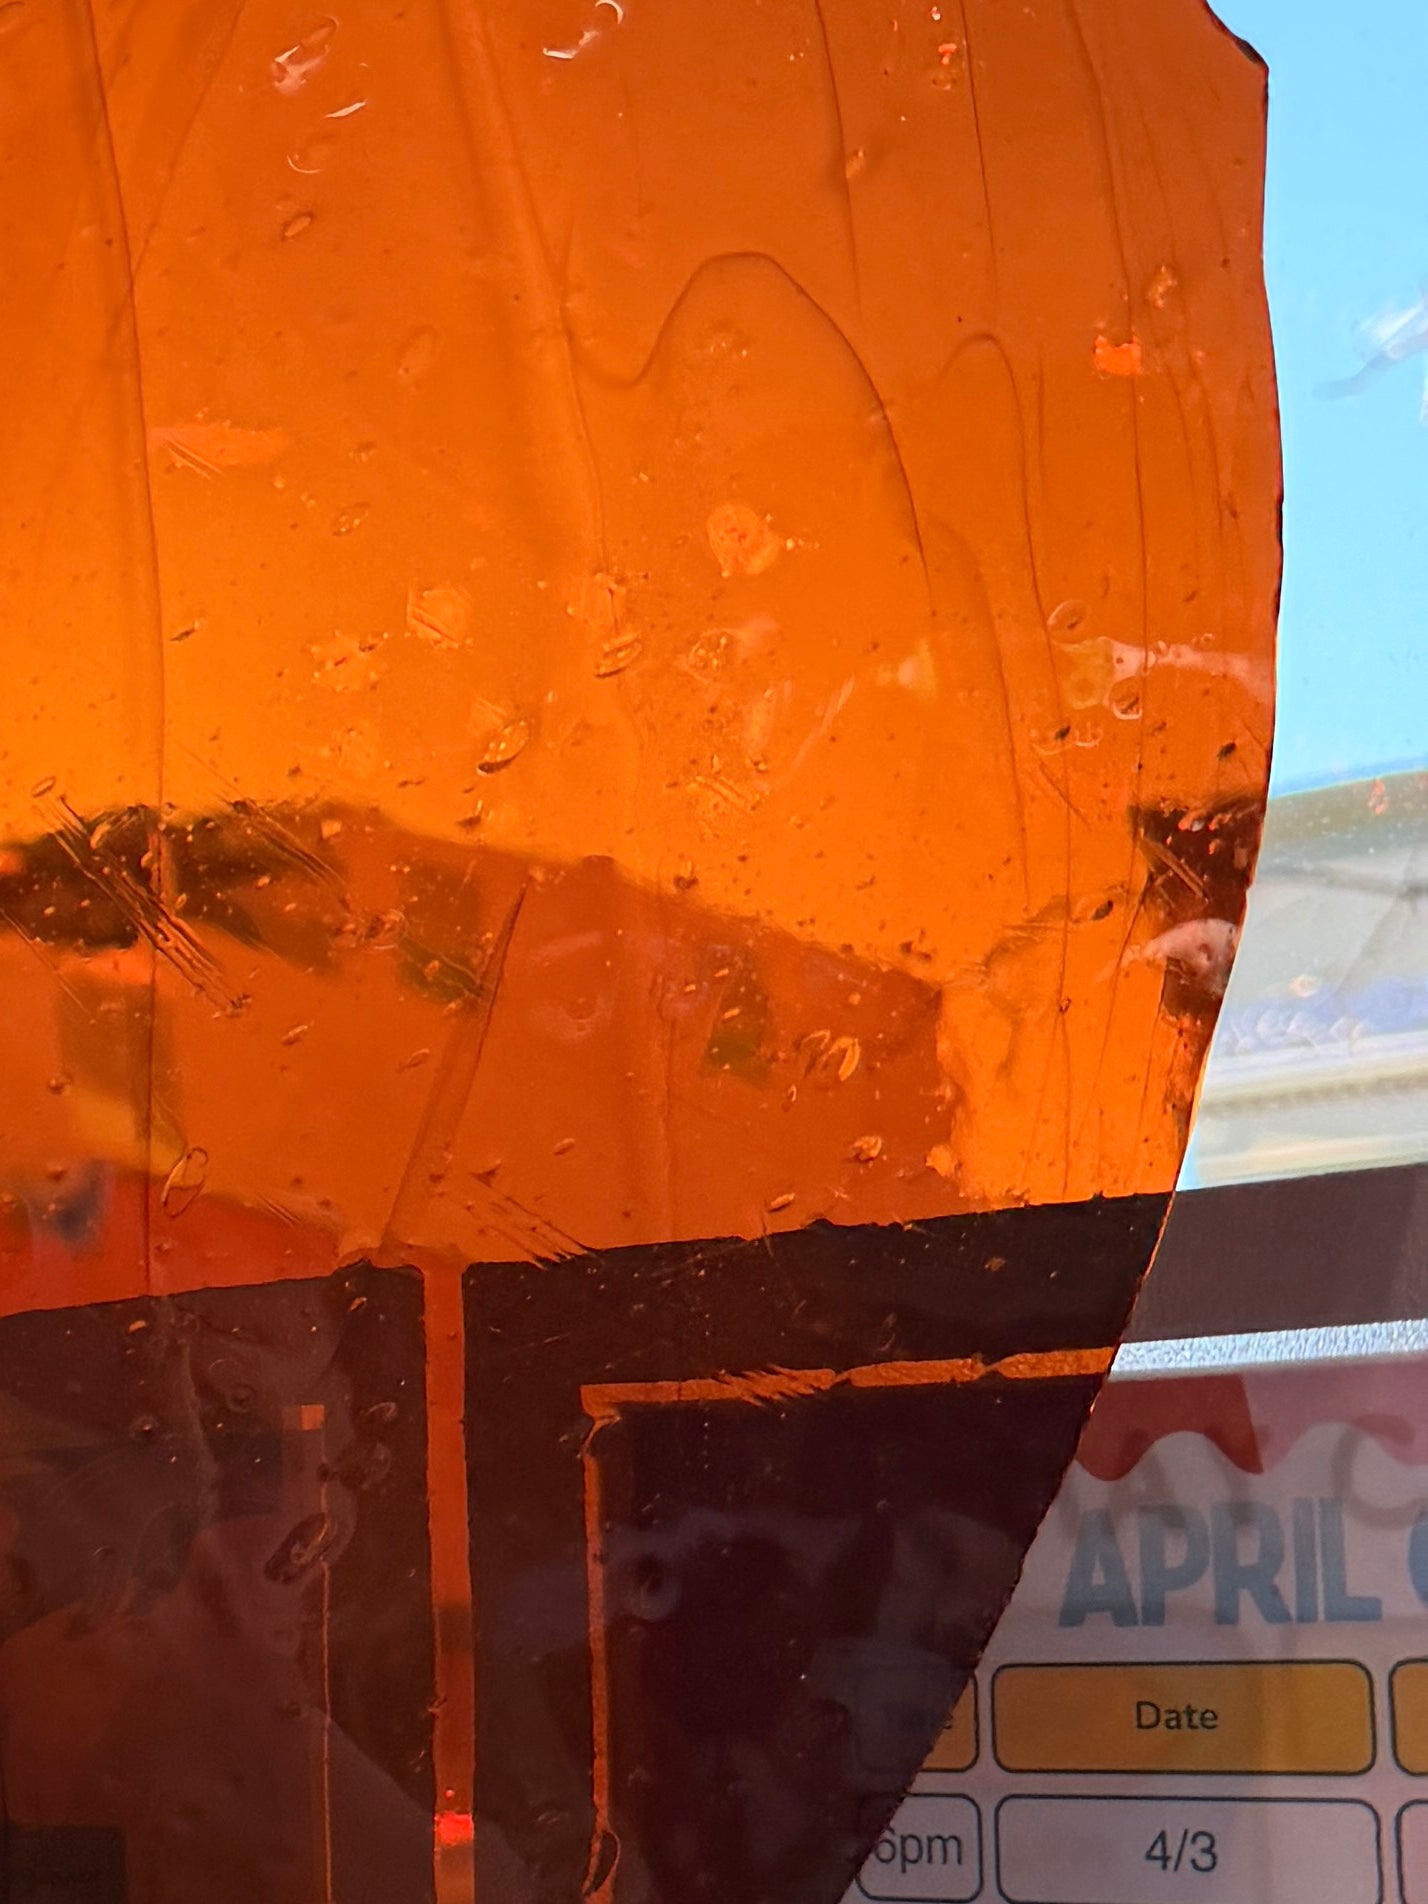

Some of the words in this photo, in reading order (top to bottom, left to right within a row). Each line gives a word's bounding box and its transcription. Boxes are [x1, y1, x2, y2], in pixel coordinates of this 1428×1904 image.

[1058, 1497, 1382, 1628] APRIL
[1135, 1700, 1219, 1730] Date
[1145, 1828, 1218, 1873] 4/3
